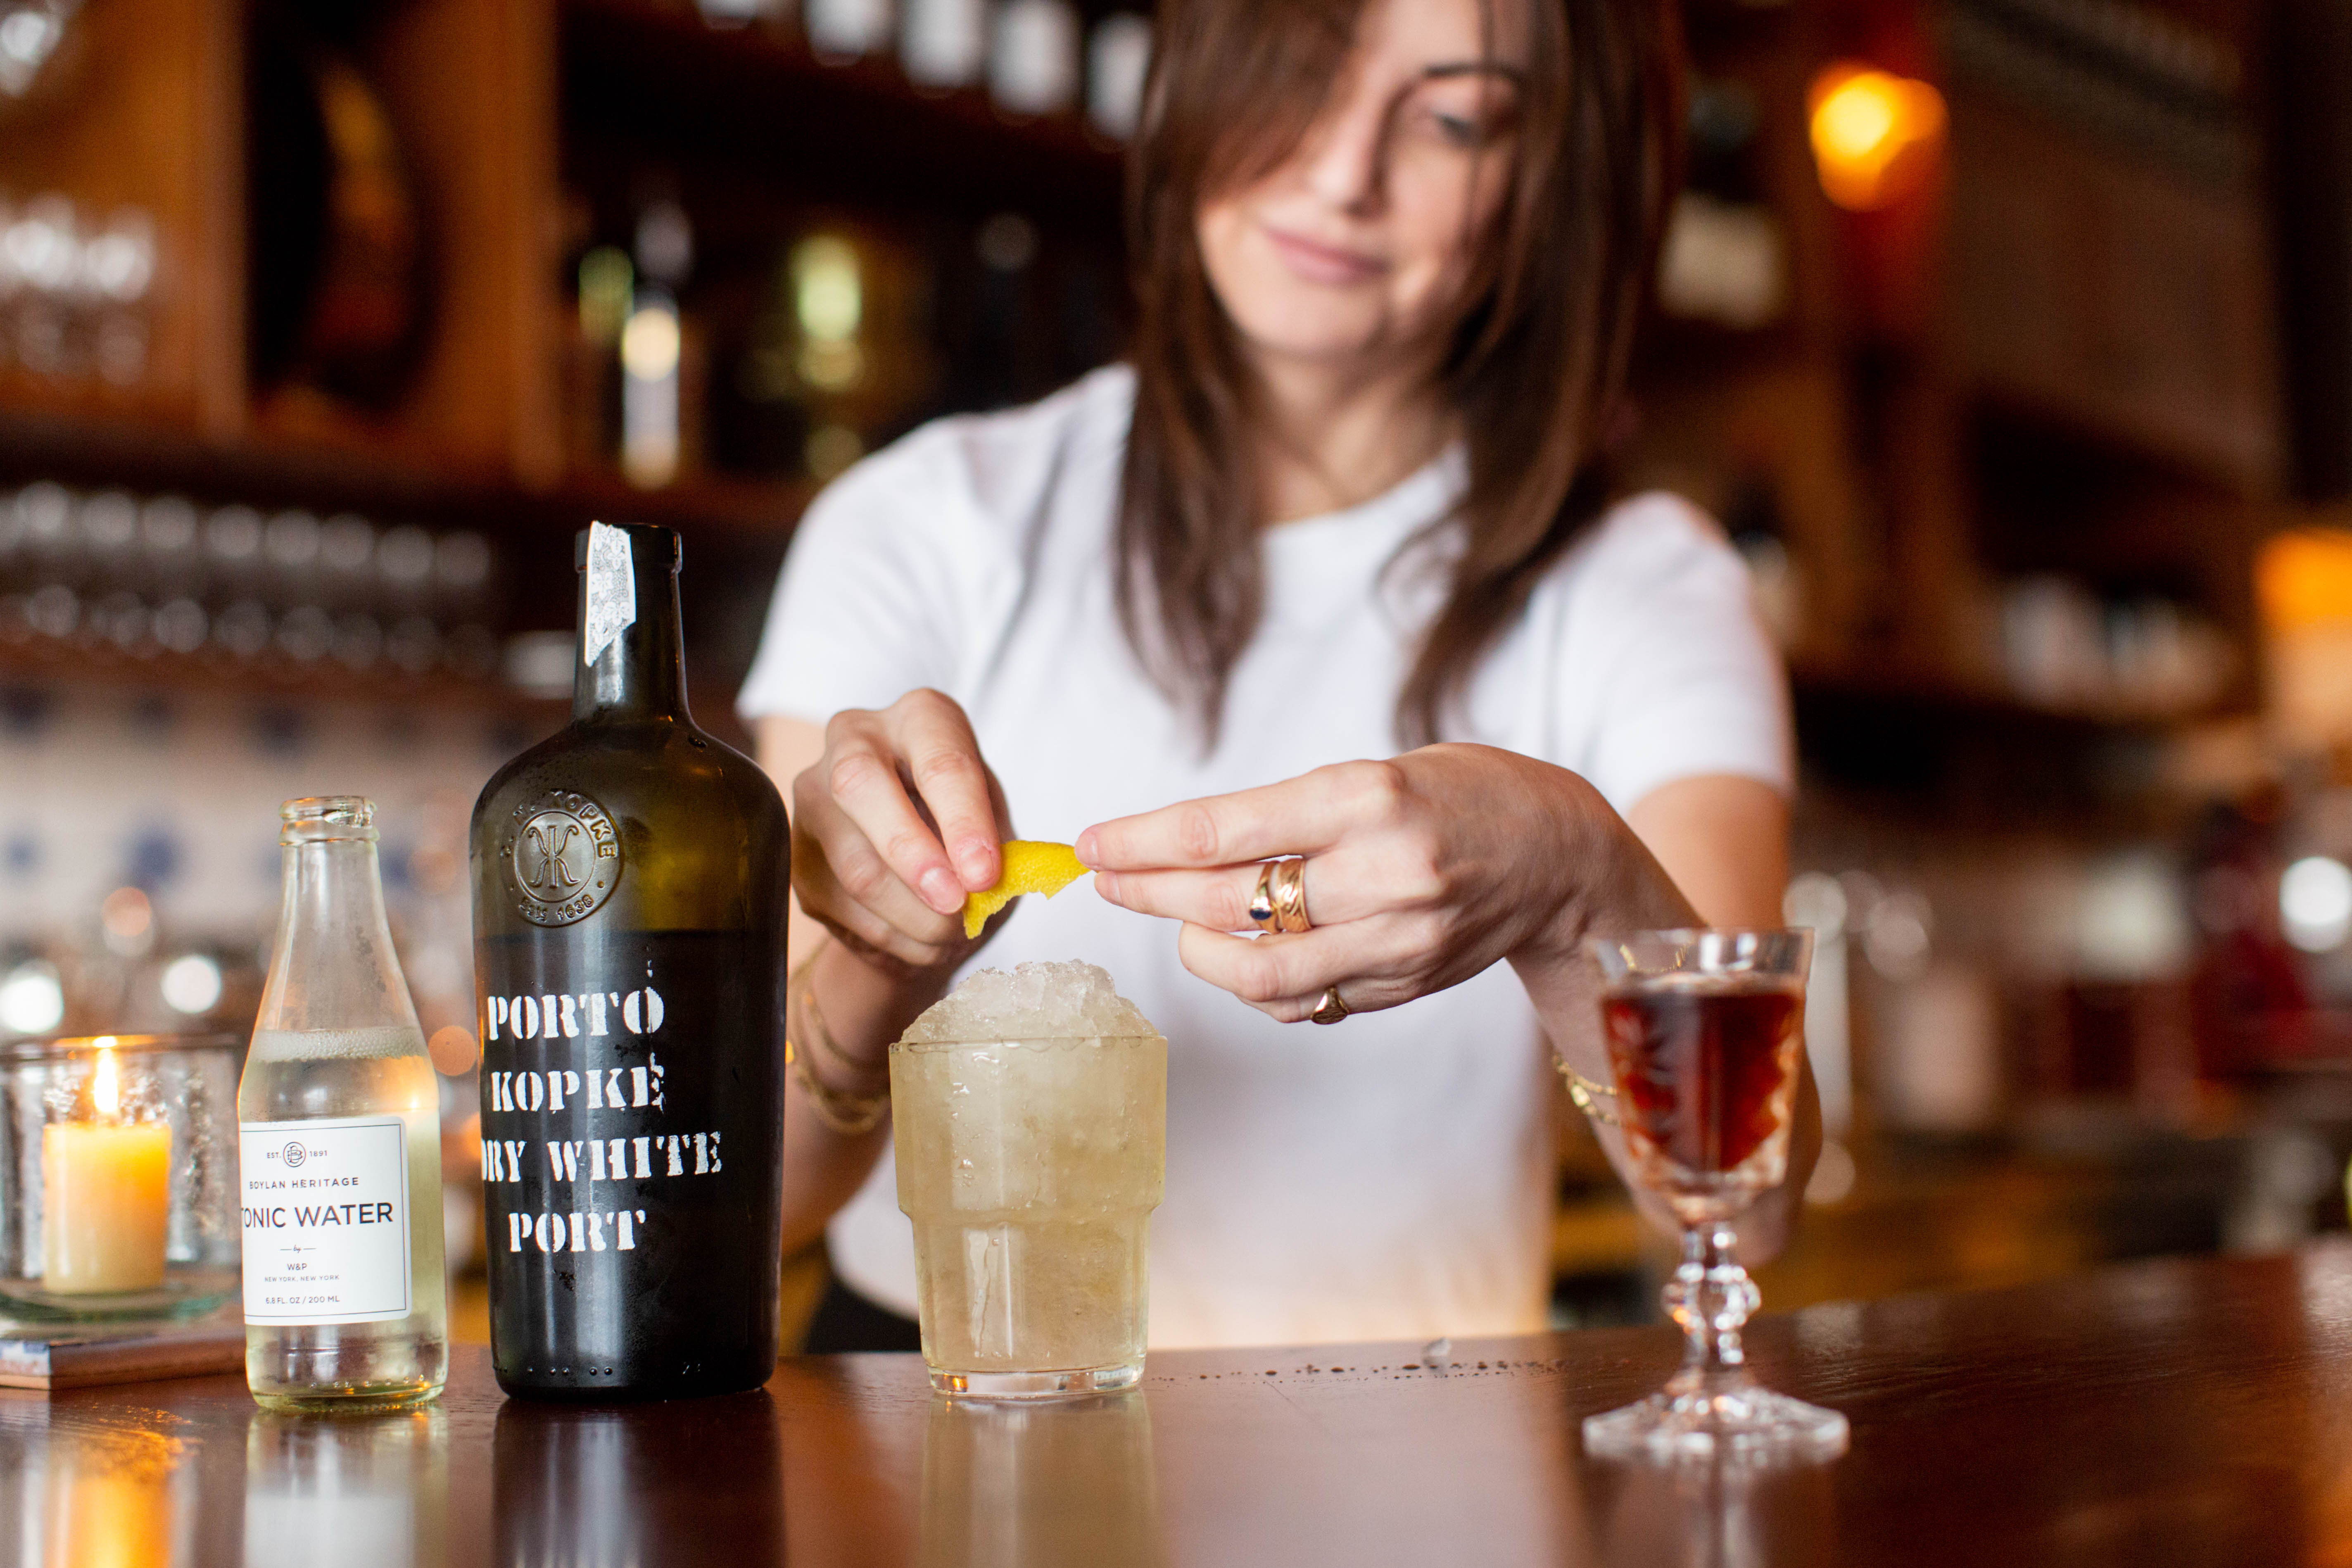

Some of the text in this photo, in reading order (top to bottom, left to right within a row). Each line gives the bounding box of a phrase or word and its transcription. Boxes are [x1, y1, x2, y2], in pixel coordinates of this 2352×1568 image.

[556, 894, 595, 921] 1638
[487, 986, 664, 1041] PORTO
[491, 1060, 664, 1112] KOPKE
[547, 1131, 722, 1182] WHITE
[249, 1177, 359, 1190] BOYLAN HERITAGE
[294, 1202, 393, 1227] WATER
[508, 1209, 646, 1252] PORT
[293, 1245, 302, 1254] by
[287, 1263, 307, 1271] W&P
[308, 1295, 325, 1304] 200
[327, 1295, 340, 1303] ML
